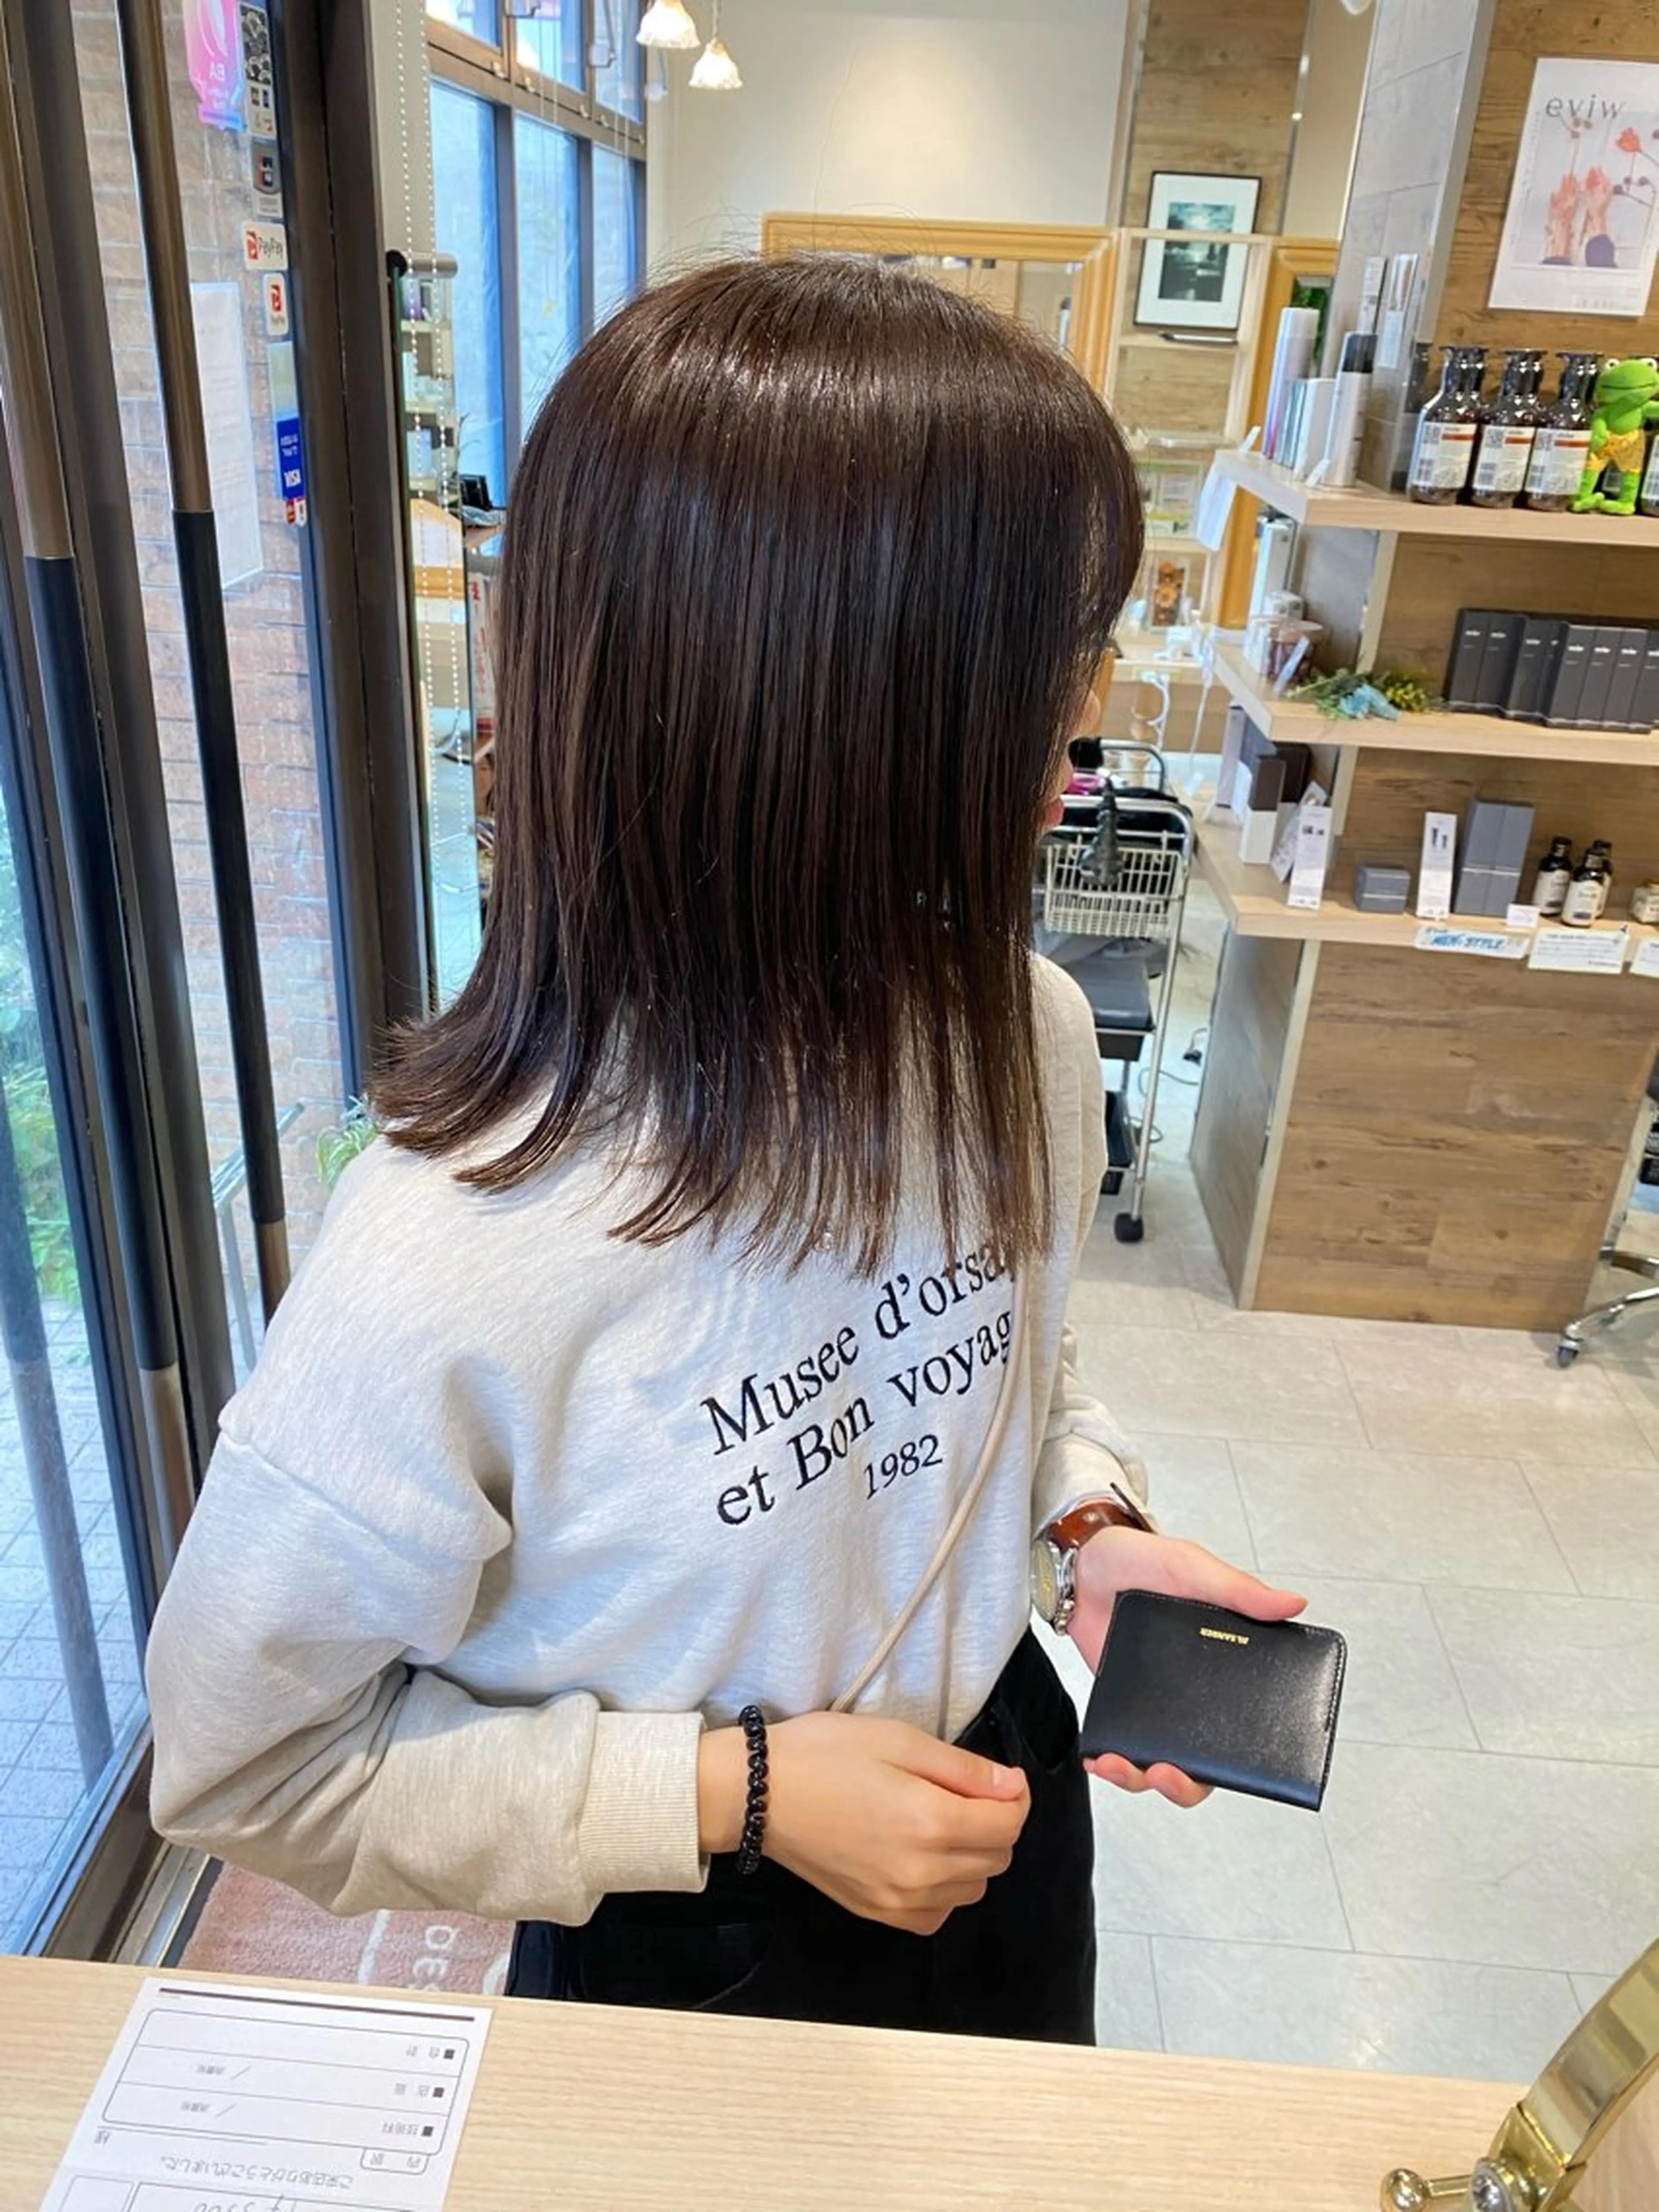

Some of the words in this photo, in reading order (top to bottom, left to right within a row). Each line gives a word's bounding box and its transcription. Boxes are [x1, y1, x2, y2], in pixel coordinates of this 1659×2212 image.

[1546, 94, 1626, 119] eviw
[700, 1326, 859, 1456] Musee
[874, 1244, 1015, 1339] d'orsa
[717, 1465, 775, 1526] et
[787, 1396, 875, 1491] Bon
[887, 1311, 1011, 1407] voyag
[864, 1434, 943, 1500] 1982
